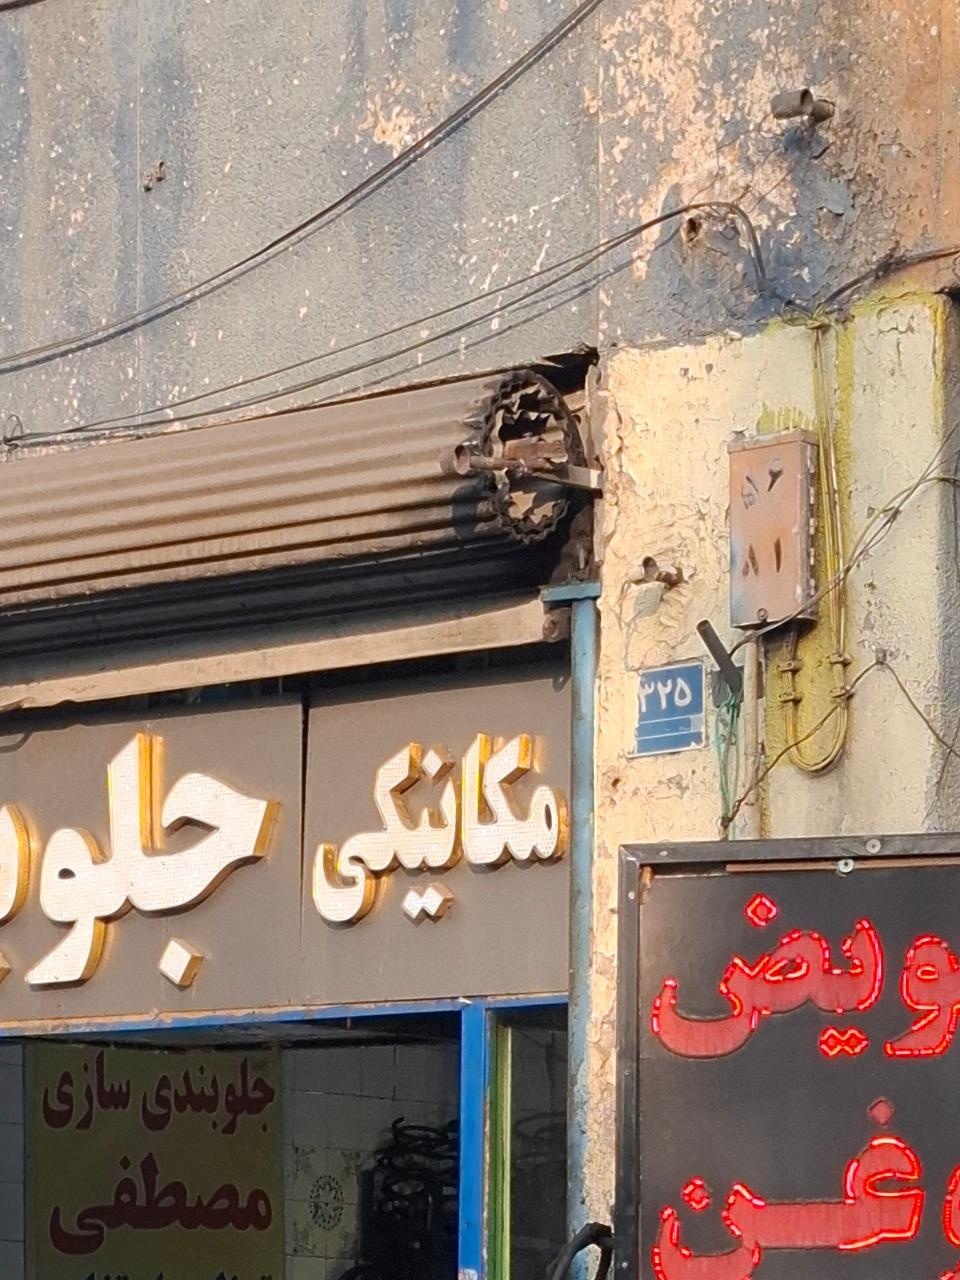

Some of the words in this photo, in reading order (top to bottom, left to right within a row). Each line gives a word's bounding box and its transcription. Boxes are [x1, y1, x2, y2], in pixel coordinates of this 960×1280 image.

[639, 677, 692, 713] ۳۲۵
[312, 732, 568, 924] مکانیکی
[651, 892, 960, 1059] ویض
[42, 1050, 131, 1130] سازی
[141, 1056, 276, 1134] جلوبندی
[48, 1152, 273, 1255] مصطفی
